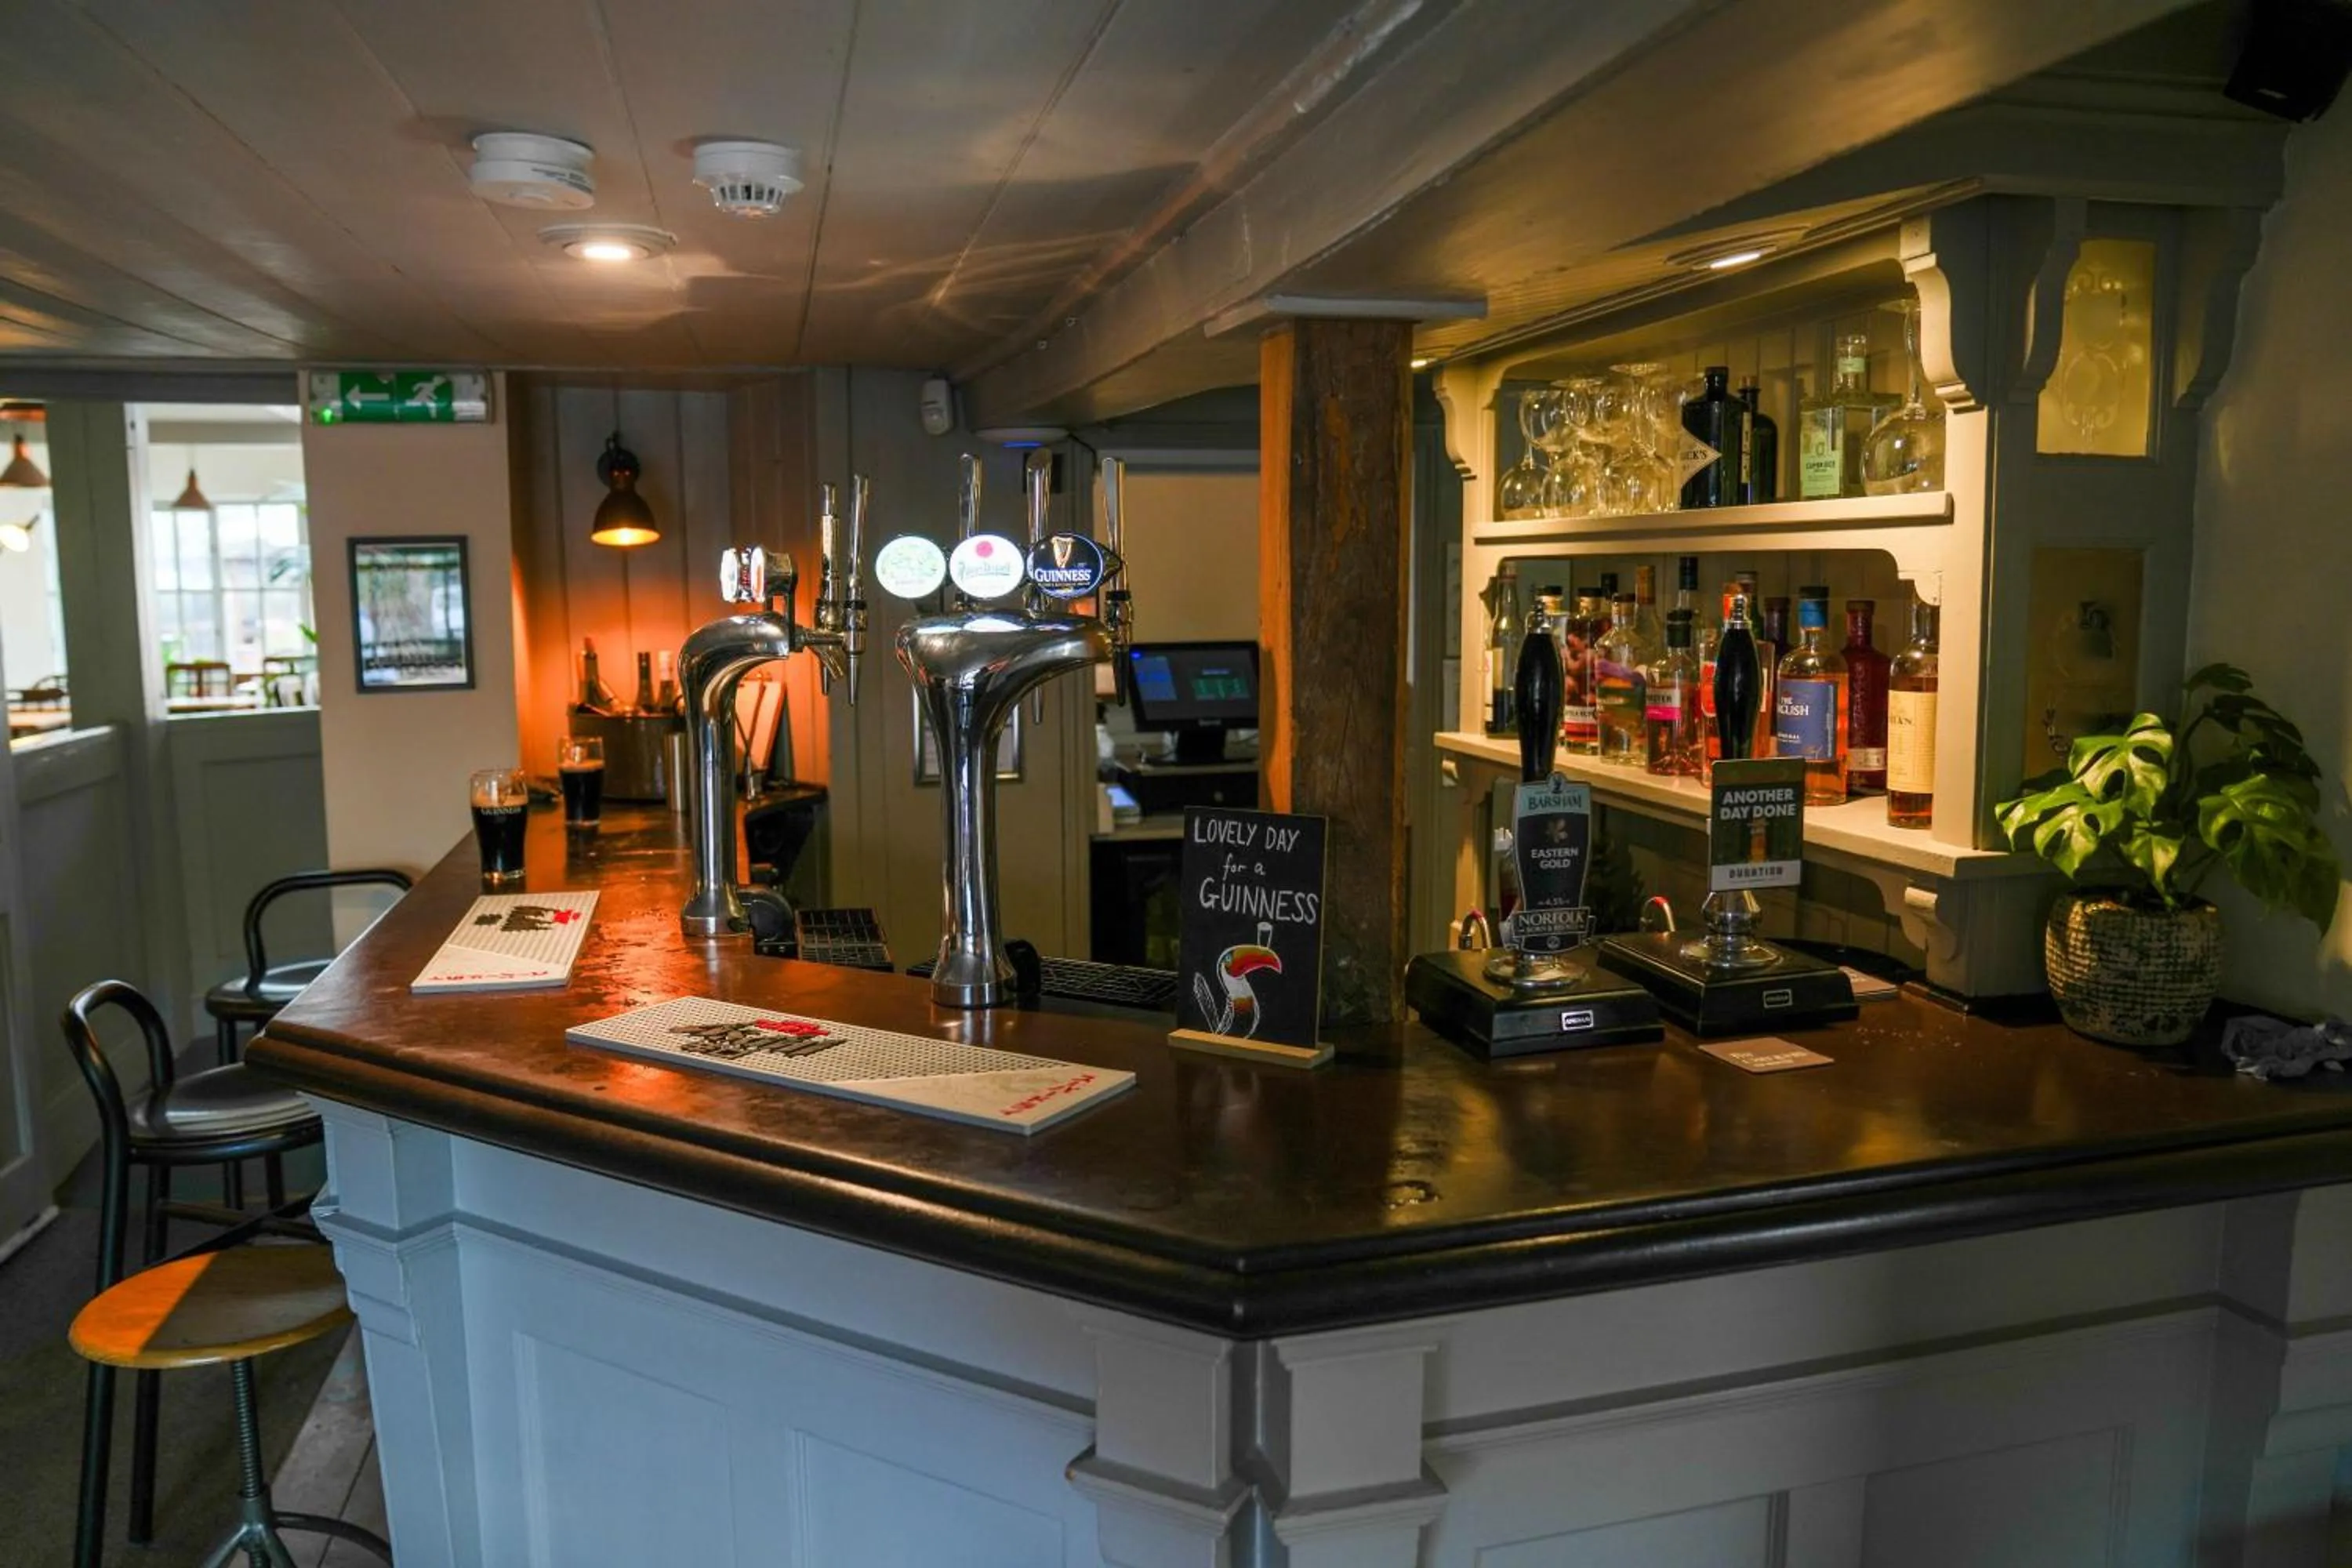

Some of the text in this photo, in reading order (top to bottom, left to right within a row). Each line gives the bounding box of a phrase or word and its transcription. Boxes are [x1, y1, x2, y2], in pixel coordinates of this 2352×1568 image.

[1035, 568, 1091, 582] GUINNESS
[1528, 794, 1582, 811] BARSHAM
[1722, 788, 1795, 805] ANOTHER
[1719, 803, 1797, 821] DAY DONE
[1194, 816, 1301, 852] LOVELY DAY
[1531, 847, 1579, 859] EASTERN
[1223, 853, 1266, 880] for a
[1540, 859, 1570, 869] GOLD
[1729, 866, 1783, 879] DURATION
[1200, 877, 1320, 925] GUINNESS
[1518, 911, 1585, 927] NORFOLK
